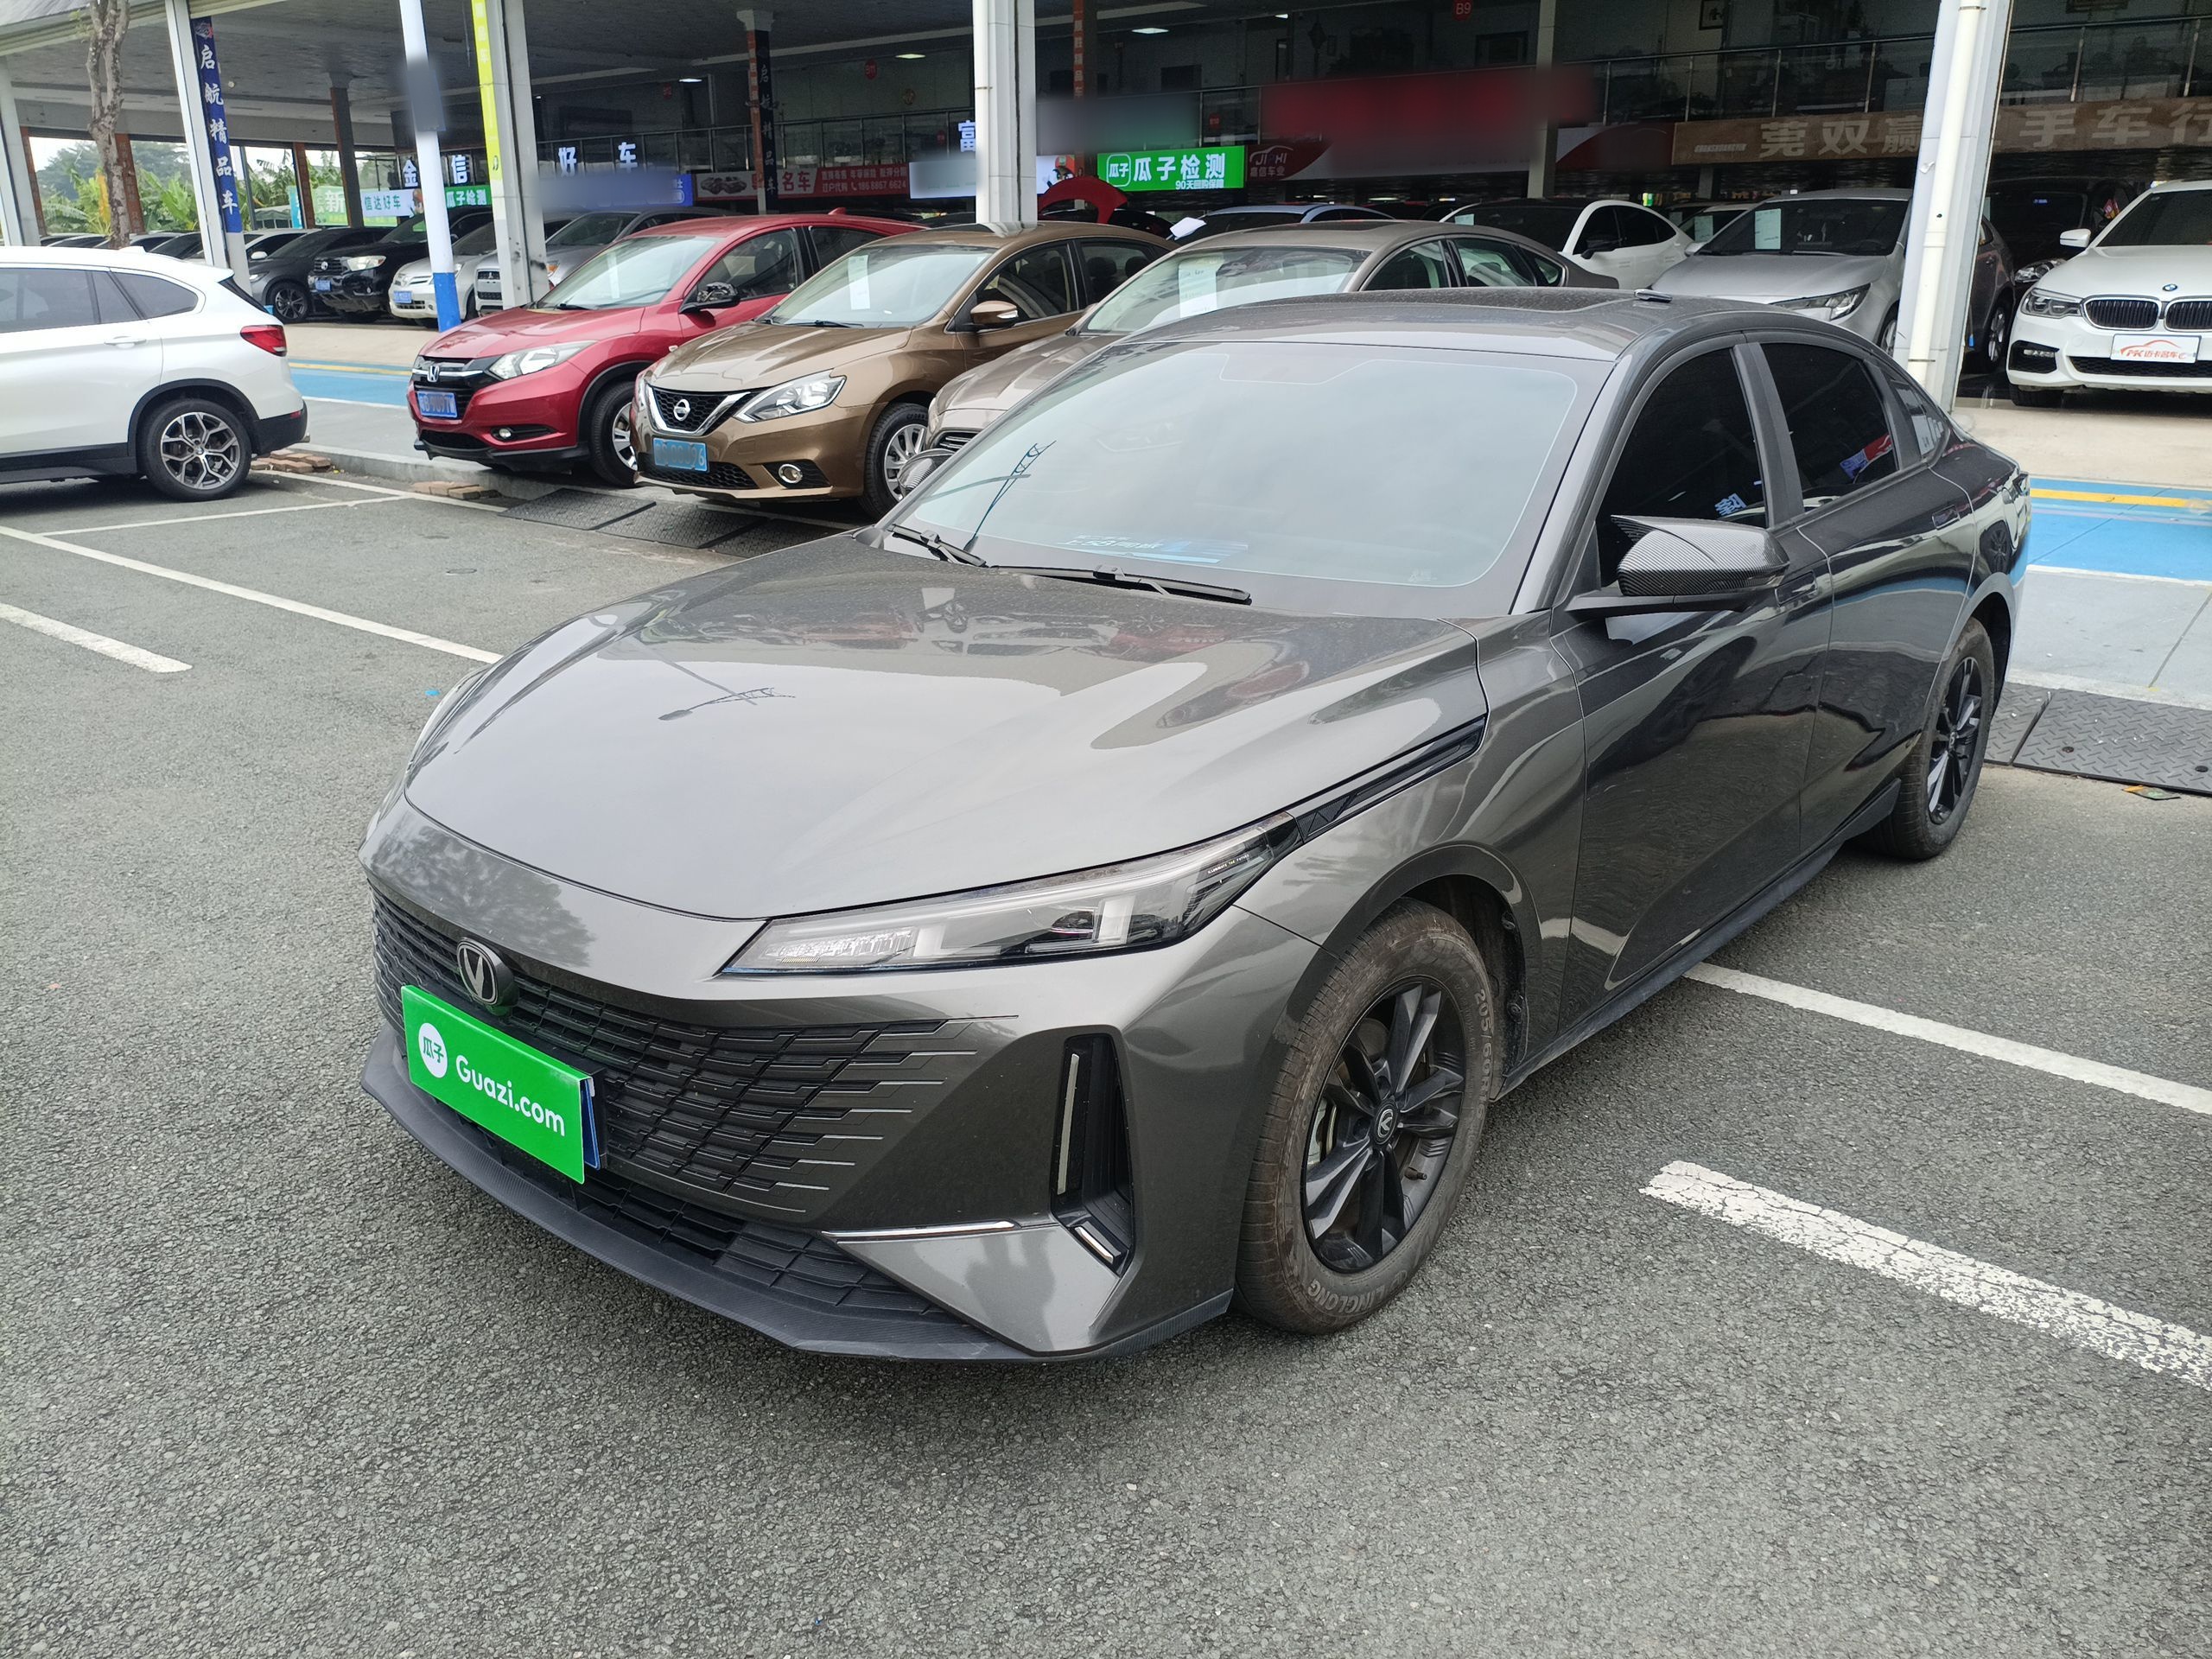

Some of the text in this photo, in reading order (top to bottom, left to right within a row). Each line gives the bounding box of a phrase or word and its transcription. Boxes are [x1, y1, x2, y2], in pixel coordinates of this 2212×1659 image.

[1456, 2, 1471, 15] B9
[200, 44, 238, 215] 启航精品车
[1109, 152, 1226, 182] 瓜子 瓜子检测
[364, 194, 402, 211] 信达好车
[422, 1036, 445, 1065] 瓜子
[455, 1054, 566, 1137] Guazi.com
[1307, 1279, 1386, 1313] LINGLONG
